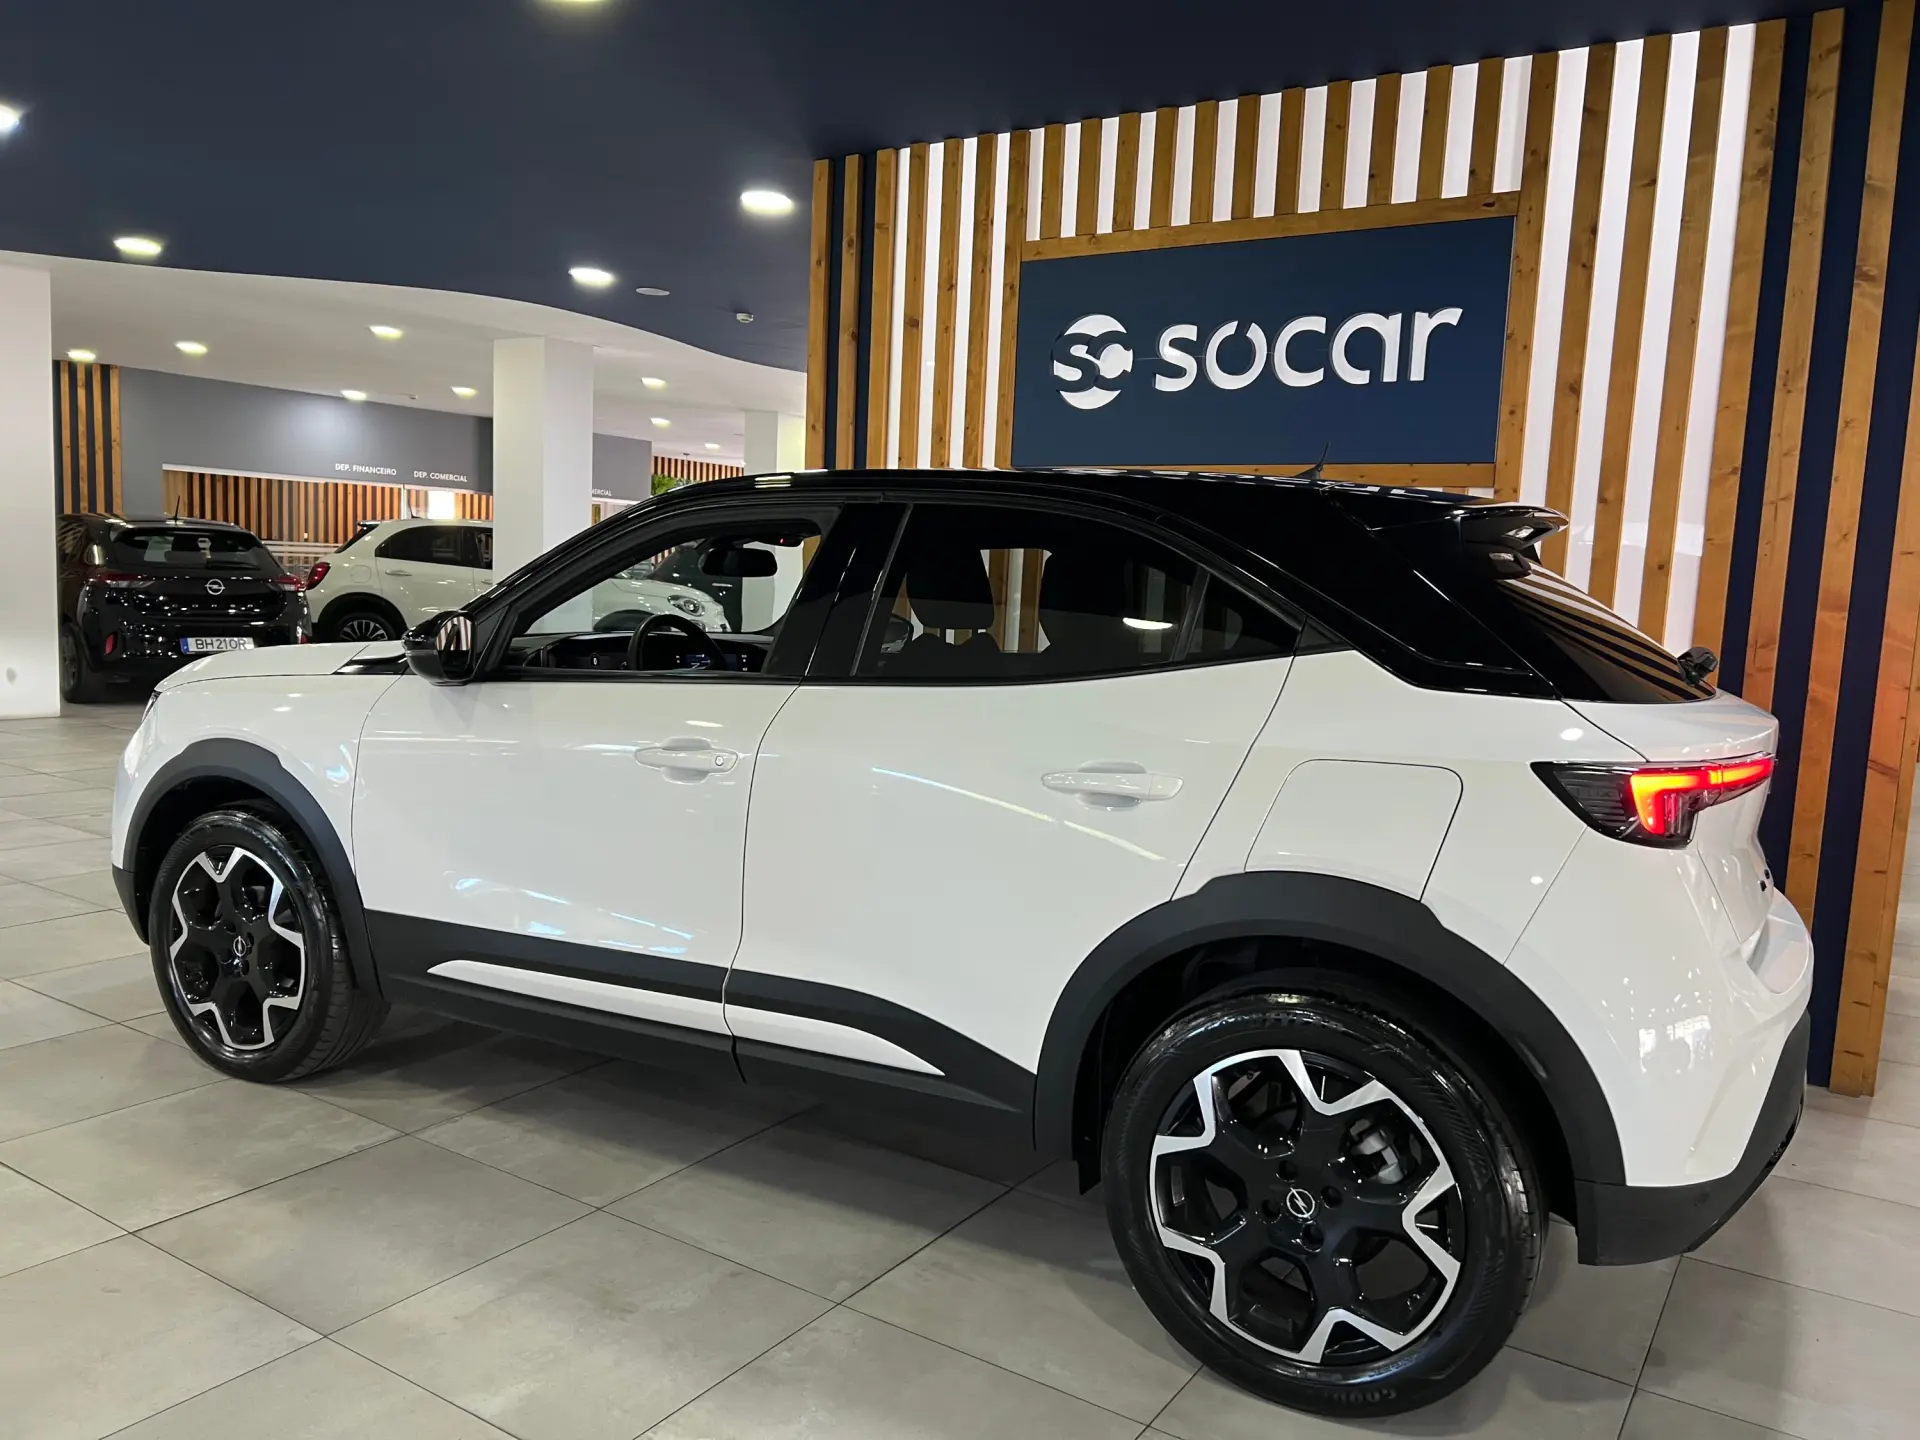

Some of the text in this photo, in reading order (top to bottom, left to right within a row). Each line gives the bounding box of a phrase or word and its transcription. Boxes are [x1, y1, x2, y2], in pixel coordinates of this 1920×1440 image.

[1152, 307, 1464, 392] socar
[335, 463, 397, 476] DEP. FINANCEIRO
[413, 470, 468, 483] DEP. COMERCIAL
